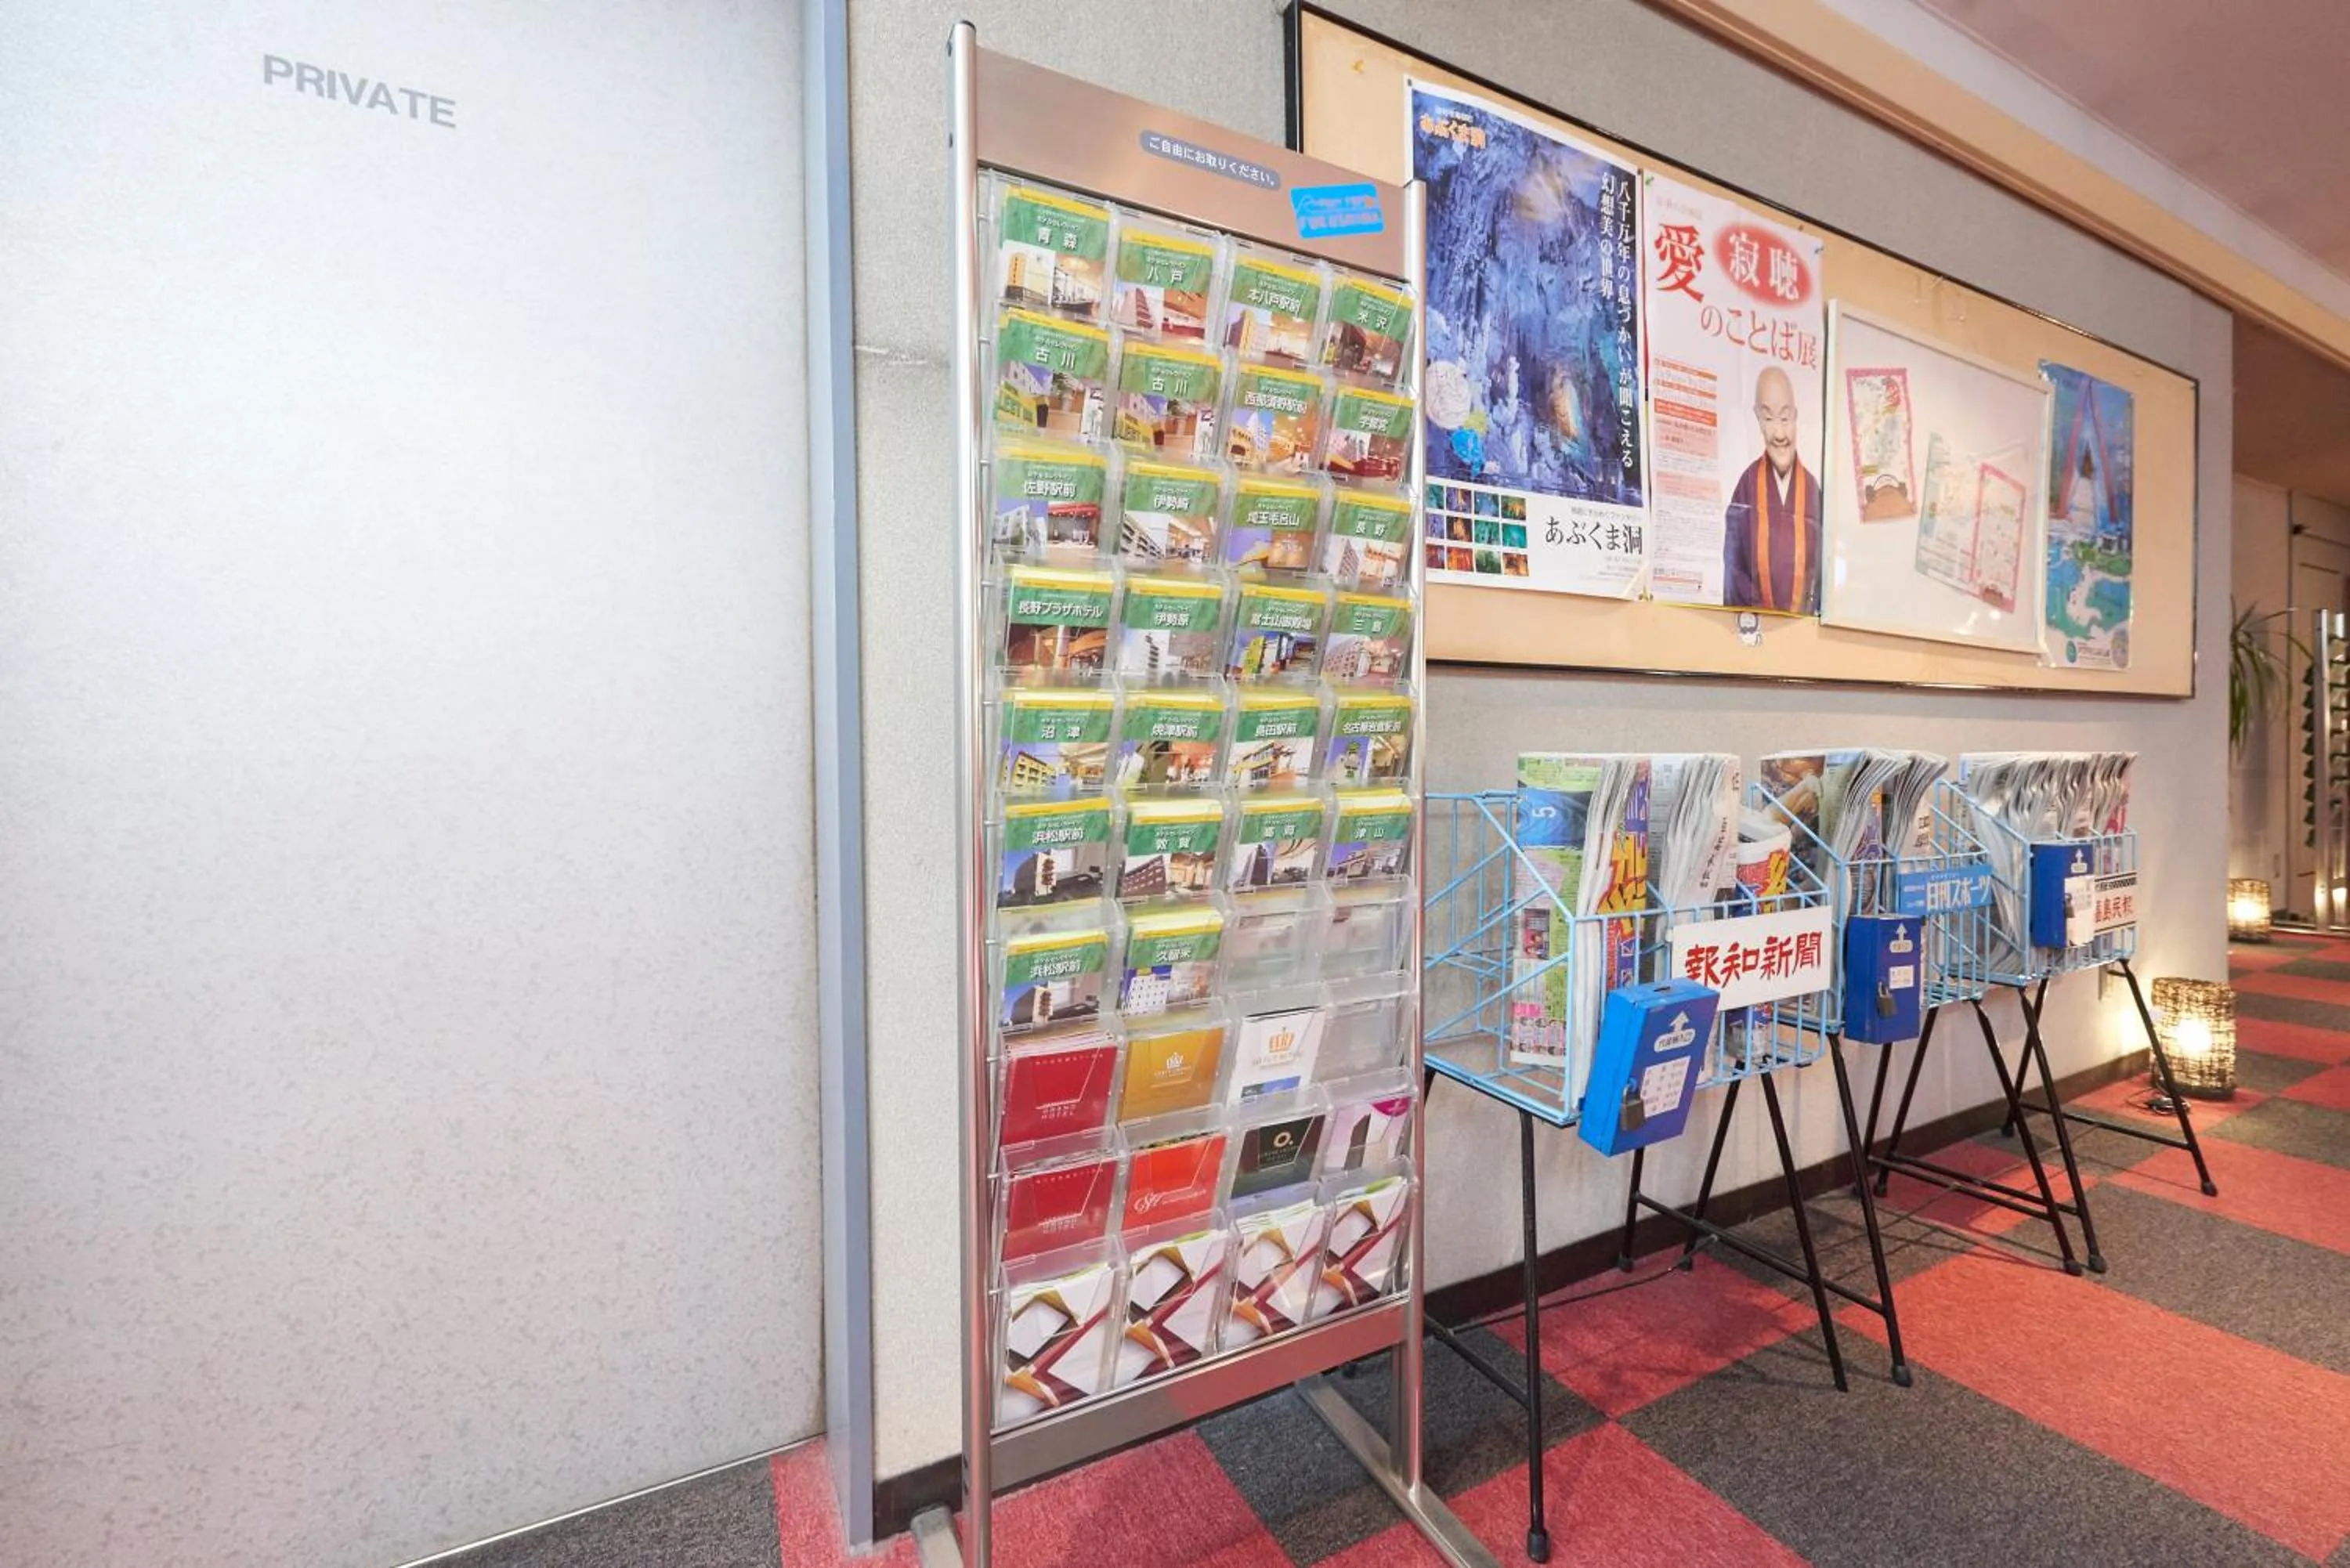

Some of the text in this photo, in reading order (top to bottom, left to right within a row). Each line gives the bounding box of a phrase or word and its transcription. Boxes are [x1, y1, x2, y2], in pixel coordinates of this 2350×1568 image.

[263, 54, 456, 128] PRIVATE
[1149, 136, 1275, 186] ご自由にお取りください。
[1600, 172, 1615, 300] 幻想美の世界
[1147, 267, 1184, 285] 八戸
[1654, 223, 1705, 302] 愛
[1729, 232, 1800, 301] 寂聴
[1036, 346, 1076, 370] 古川
[1701, 305, 1817, 370] のことば展
[1152, 376, 1188, 393] 古川
[1546, 515, 1643, 555] あぶくま洞
[1018, 601, 1103, 618] 長野プラザホテル
[1926, 875, 1990, 911] 日刊スポーツ
[1685, 930, 1822, 988] 報知新聞
